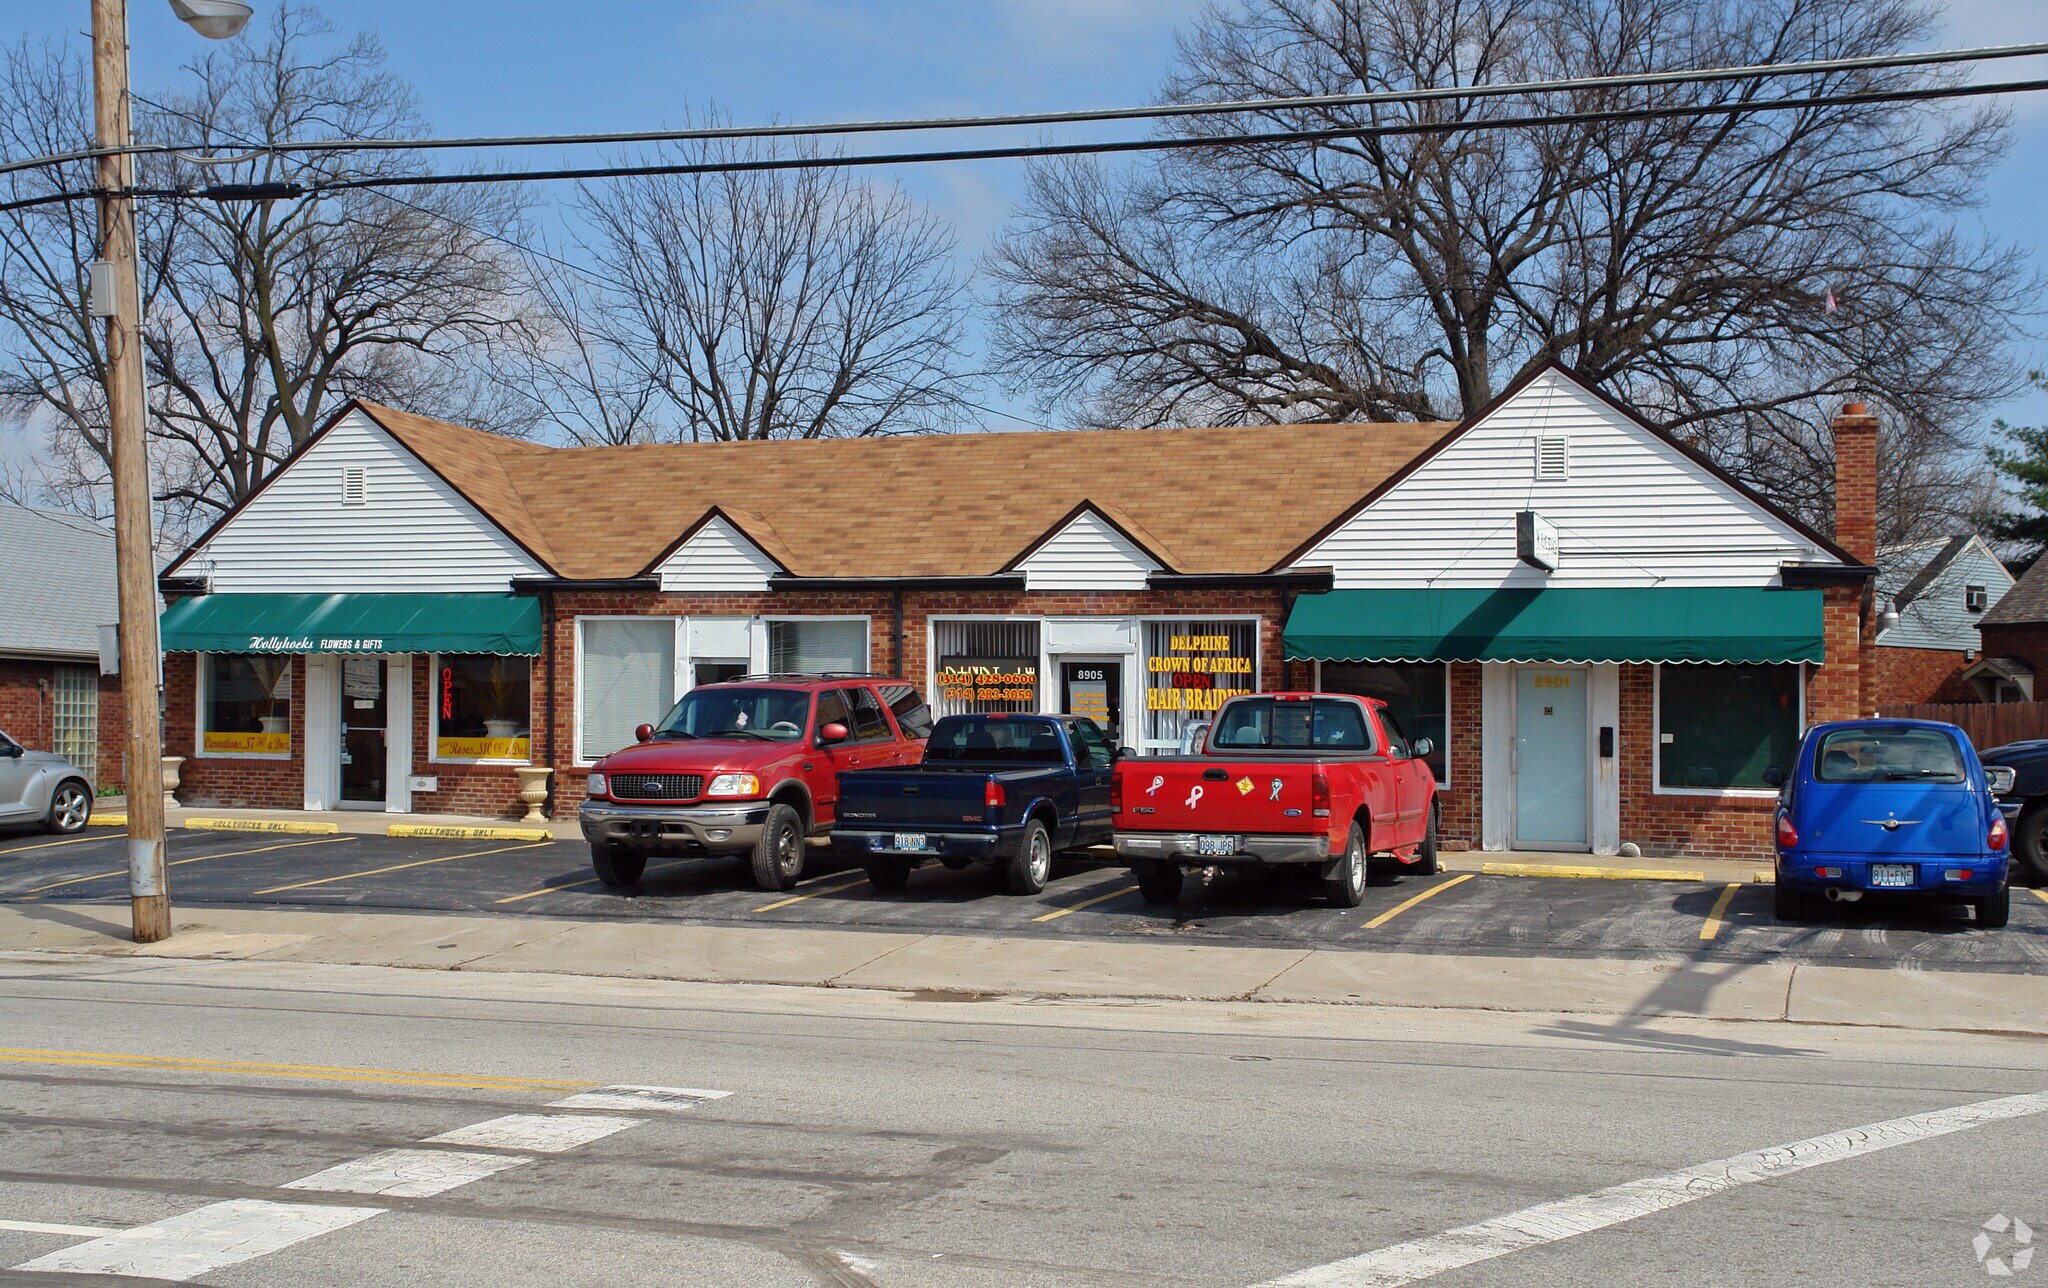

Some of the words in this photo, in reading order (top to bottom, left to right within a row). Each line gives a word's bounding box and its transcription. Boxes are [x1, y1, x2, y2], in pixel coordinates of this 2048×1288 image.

[248, 636, 313, 651] Hollyhocks
[320, 639, 352, 649] FLOWERS
[354, 640, 361, 649] &
[362, 640, 383, 649] GIFTS
[1170, 635, 1230, 651] DELPHINE
[1148, 656, 1191, 673] CROWN
[1193, 656, 1208, 673] OF
[1209, 657, 1252, 673] AFRICA
[937, 672, 973, 686] (314)
[975, 673, 1037, 685] 428-0600
[1078, 670, 1103, 680] 8905
[1173, 674, 1211, 689] OPEN
[1535, 675, 1570, 689] 8901
[443, 667, 453, 720] OPEN
[944, 687, 974, 702] (314)
[977, 688, 1033, 701] 283-3059
[1147, 687, 1182, 710] HAIR
[1184, 688, 1252, 711] BRAID
[449, 742, 474, 755] Roses
[212, 820, 262, 829] HOLLYHOCKS
[267, 822, 288, 830] ONLY
[413, 827, 466, 836] HOLLYHOCKS
[473, 829, 495, 837] ONLY
[895, 836, 908, 847] 918
[1200, 840, 1215, 851] 098
[1218, 840, 1233, 851] JP6
